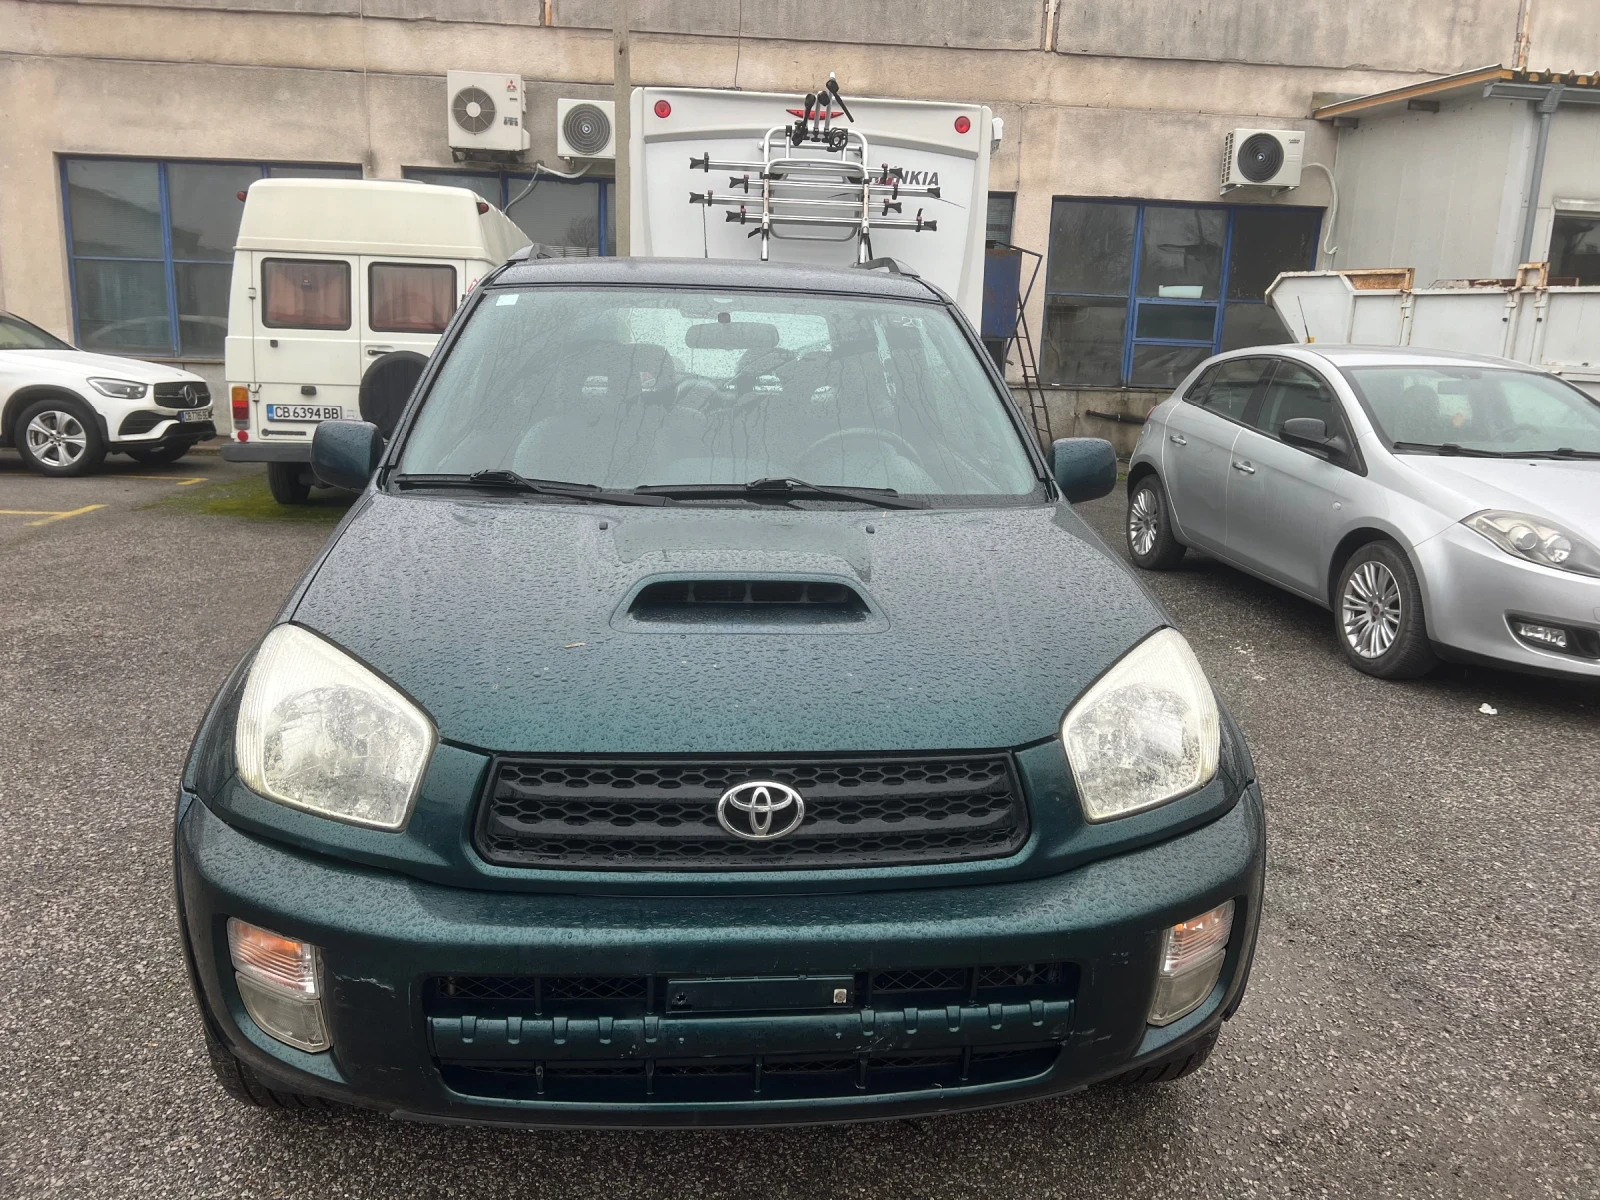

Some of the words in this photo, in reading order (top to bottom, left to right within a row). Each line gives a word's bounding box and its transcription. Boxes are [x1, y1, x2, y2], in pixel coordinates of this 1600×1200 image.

[874, 168, 939, 186] NKIA
[275, 406, 290, 418] CB
[292, 407, 321, 419] 6394
[323, 407, 339, 419] BB
